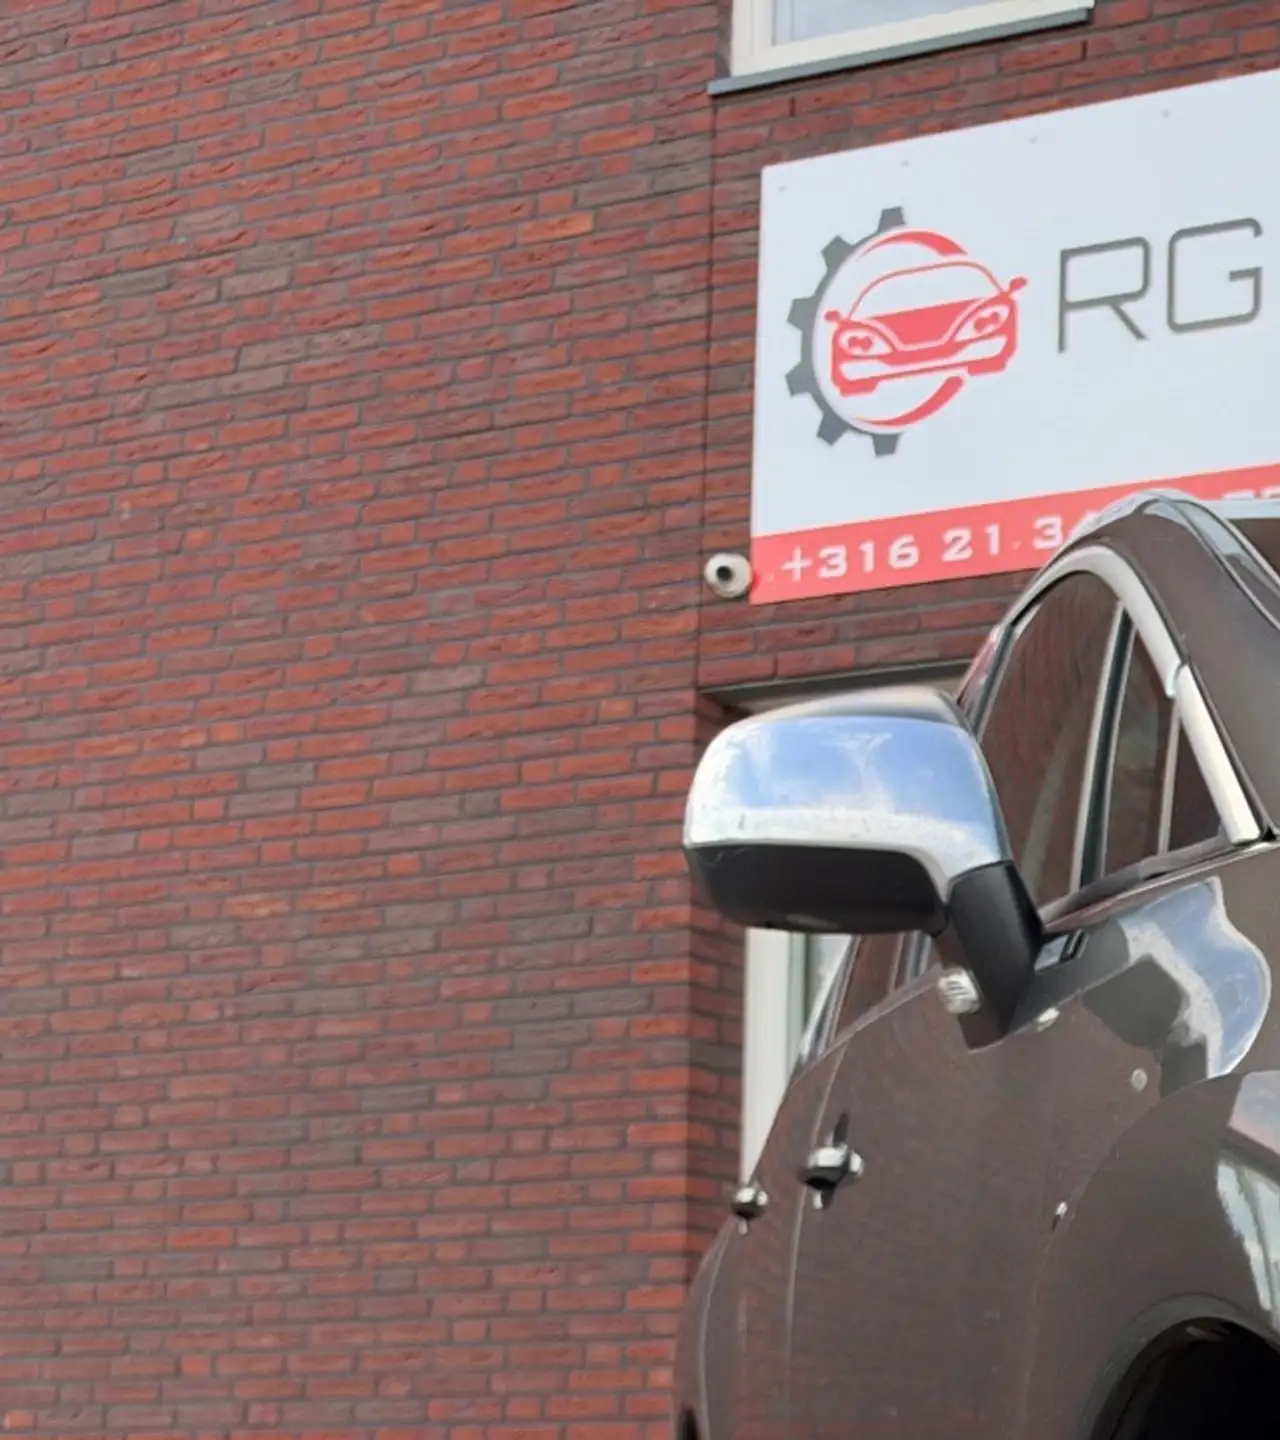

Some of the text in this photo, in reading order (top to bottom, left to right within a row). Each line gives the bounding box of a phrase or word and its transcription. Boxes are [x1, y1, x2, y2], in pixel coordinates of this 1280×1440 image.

[1057, 216, 1263, 354] RG
[781, 533, 919, 582] +316
[942, 526, 999, 562] 21
